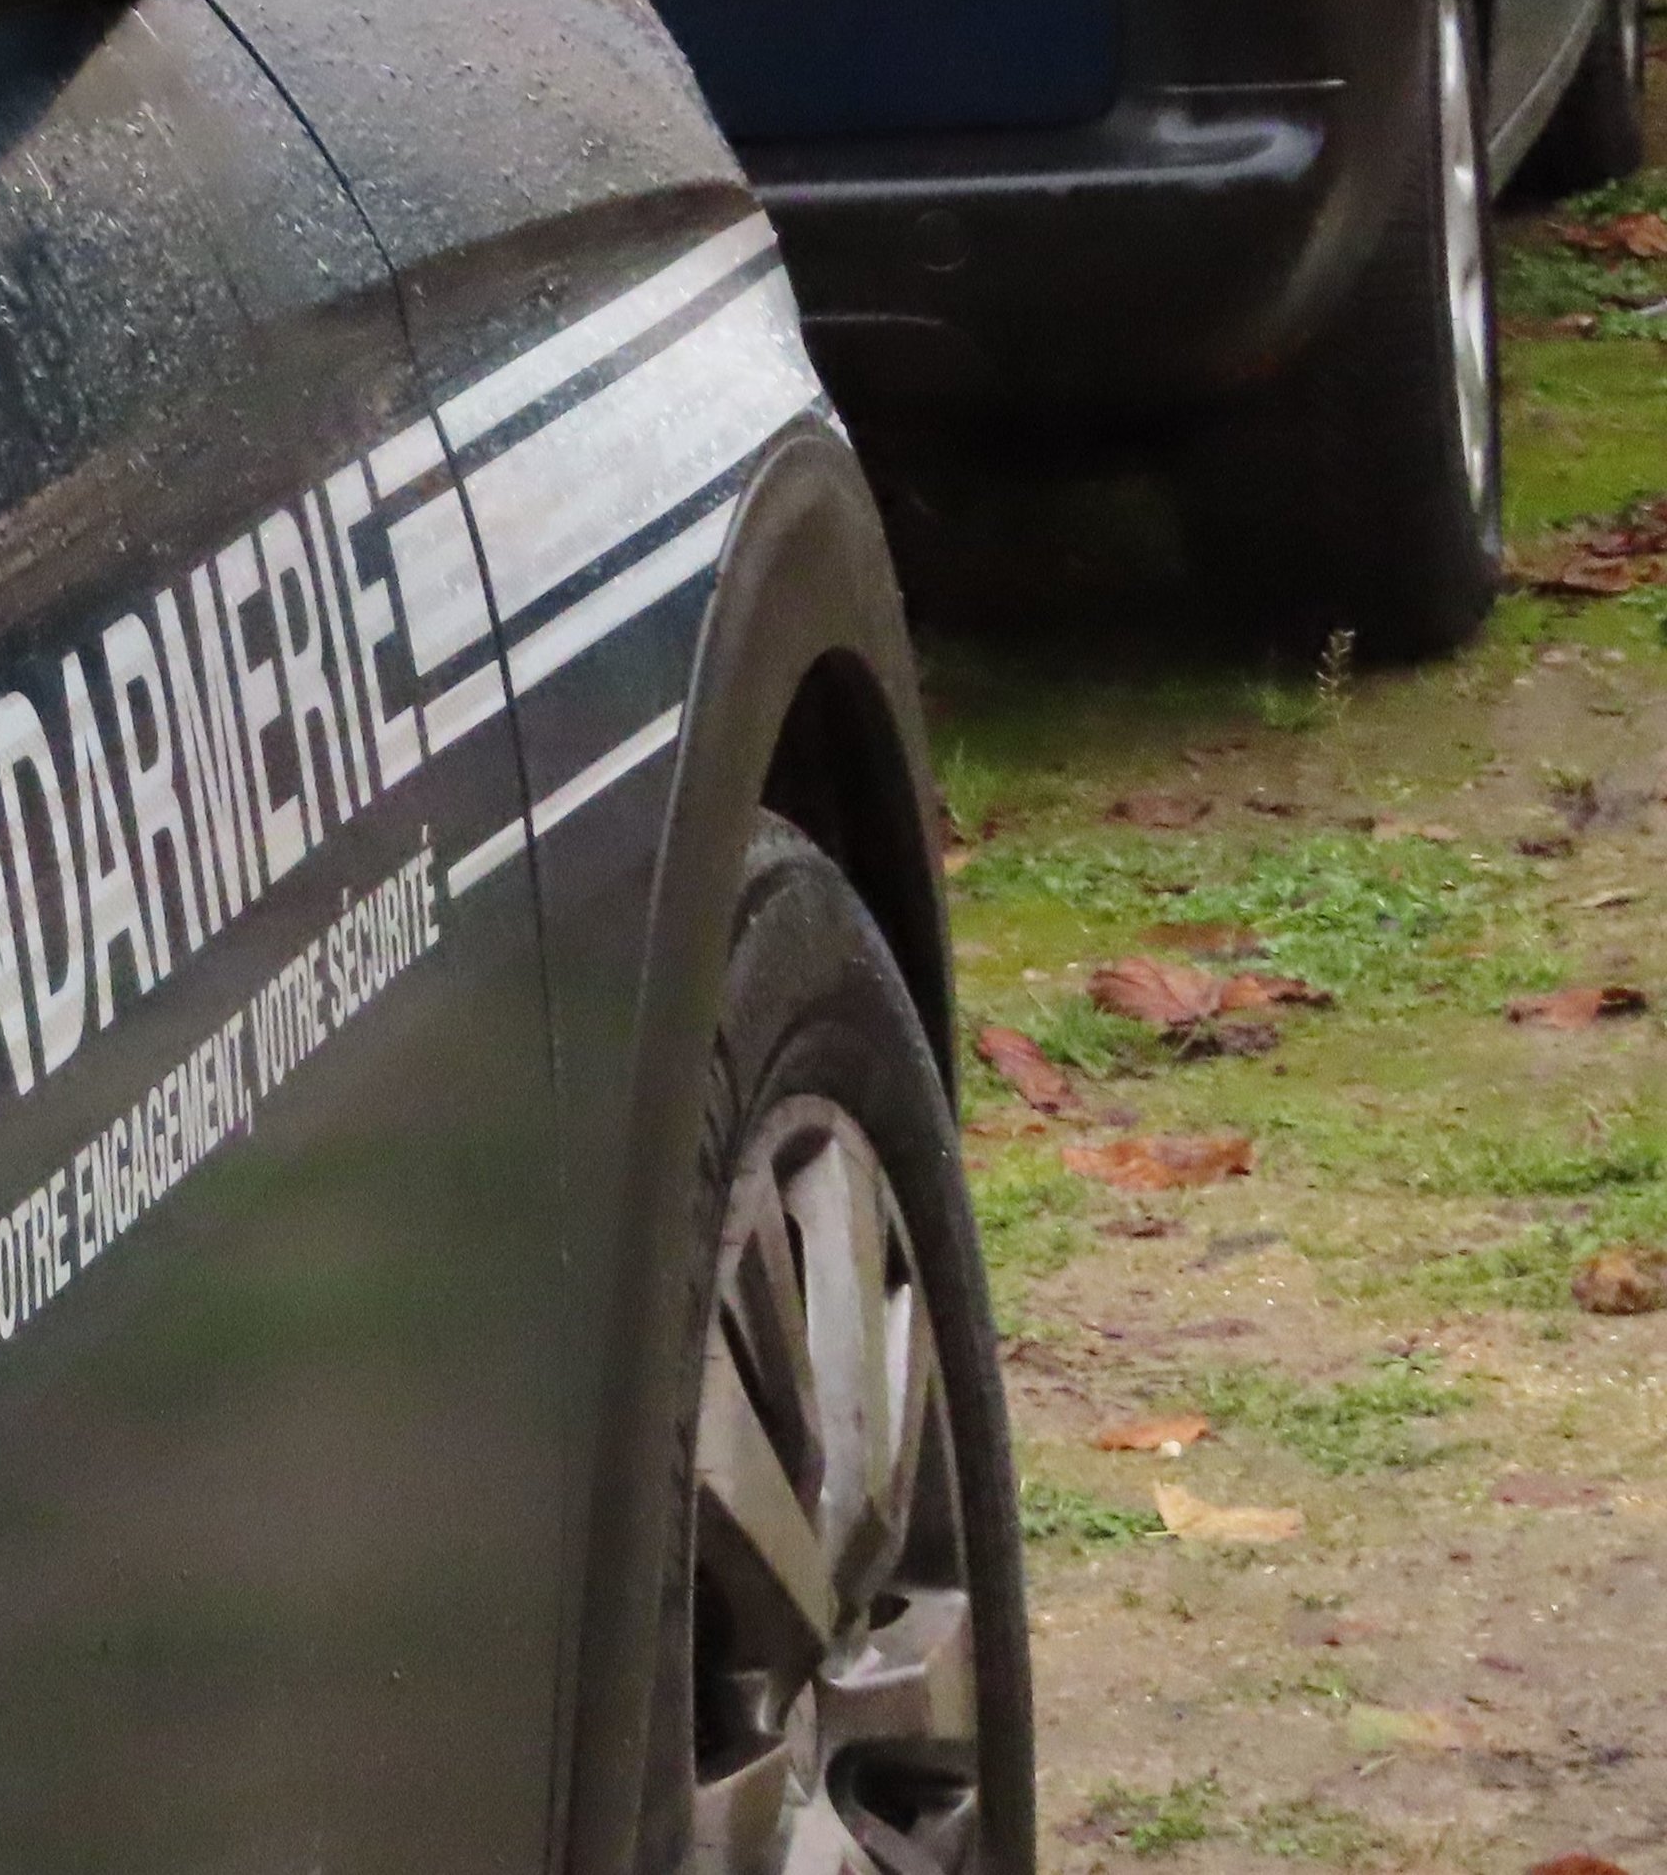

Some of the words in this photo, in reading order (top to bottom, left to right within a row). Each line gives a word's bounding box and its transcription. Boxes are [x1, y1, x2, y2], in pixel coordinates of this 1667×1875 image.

[73, 1011, 252, 1269] ENGAGEMENT,
[250, 938, 328, 1098] VOTRE
[326, 824, 441, 1029] SÉCURITÉ
